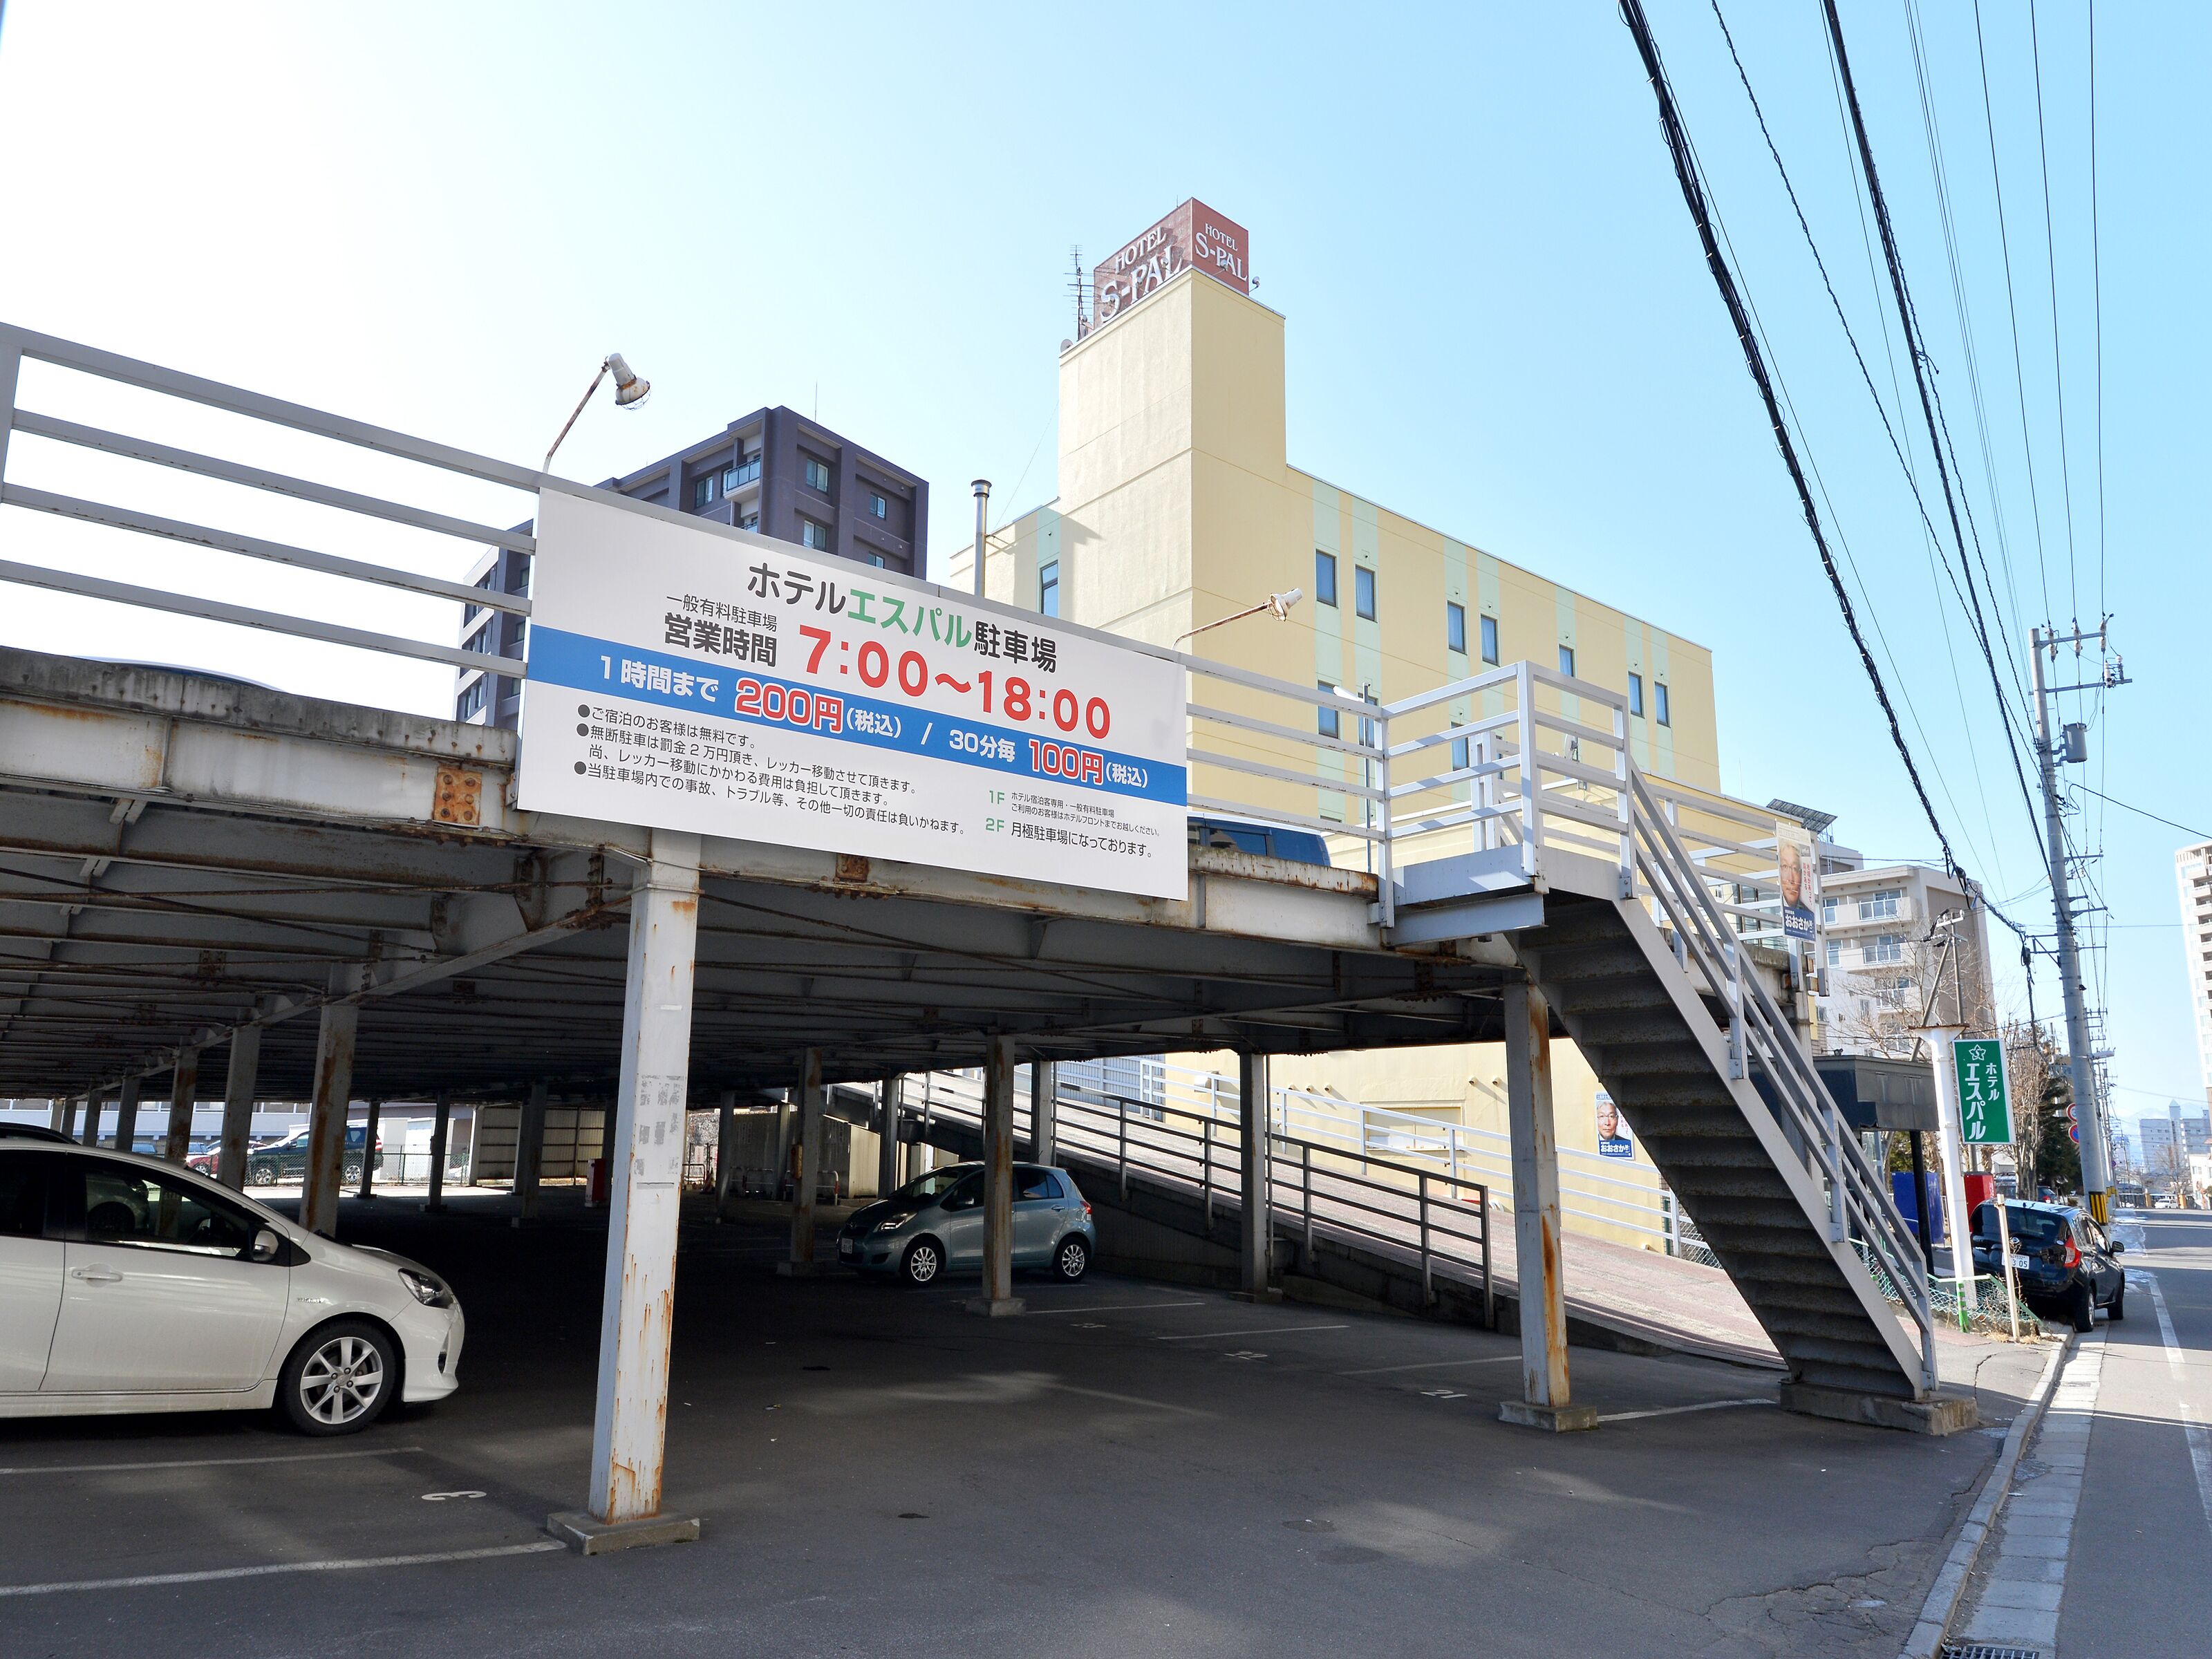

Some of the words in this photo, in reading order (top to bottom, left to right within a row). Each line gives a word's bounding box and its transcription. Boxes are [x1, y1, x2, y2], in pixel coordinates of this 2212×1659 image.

[1115, 226, 1168, 274] HOTEL
[1194, 232, 1248, 281] S-PAL
[1205, 223, 1238, 252] HOTEL
[1098, 244, 1183, 324] S-PAL
[666, 594, 778, 632] 一般有料駐車場
[747, 562, 1057, 673] ホテルエスパル駐車場
[664, 612, 778, 667] 営業時間
[591, 706, 756, 749] ご宿泊のお客様は無料です。
[949, 729, 1015, 762] 30分毎
[988, 790, 1005, 805] 1F
[985, 817, 1005, 832] 2F
[1011, 821, 1152, 858] 月極駐車場になっております。
[1965, 1062, 1986, 1140] エスパル
[1985, 1062, 2000, 1100] ホテル
